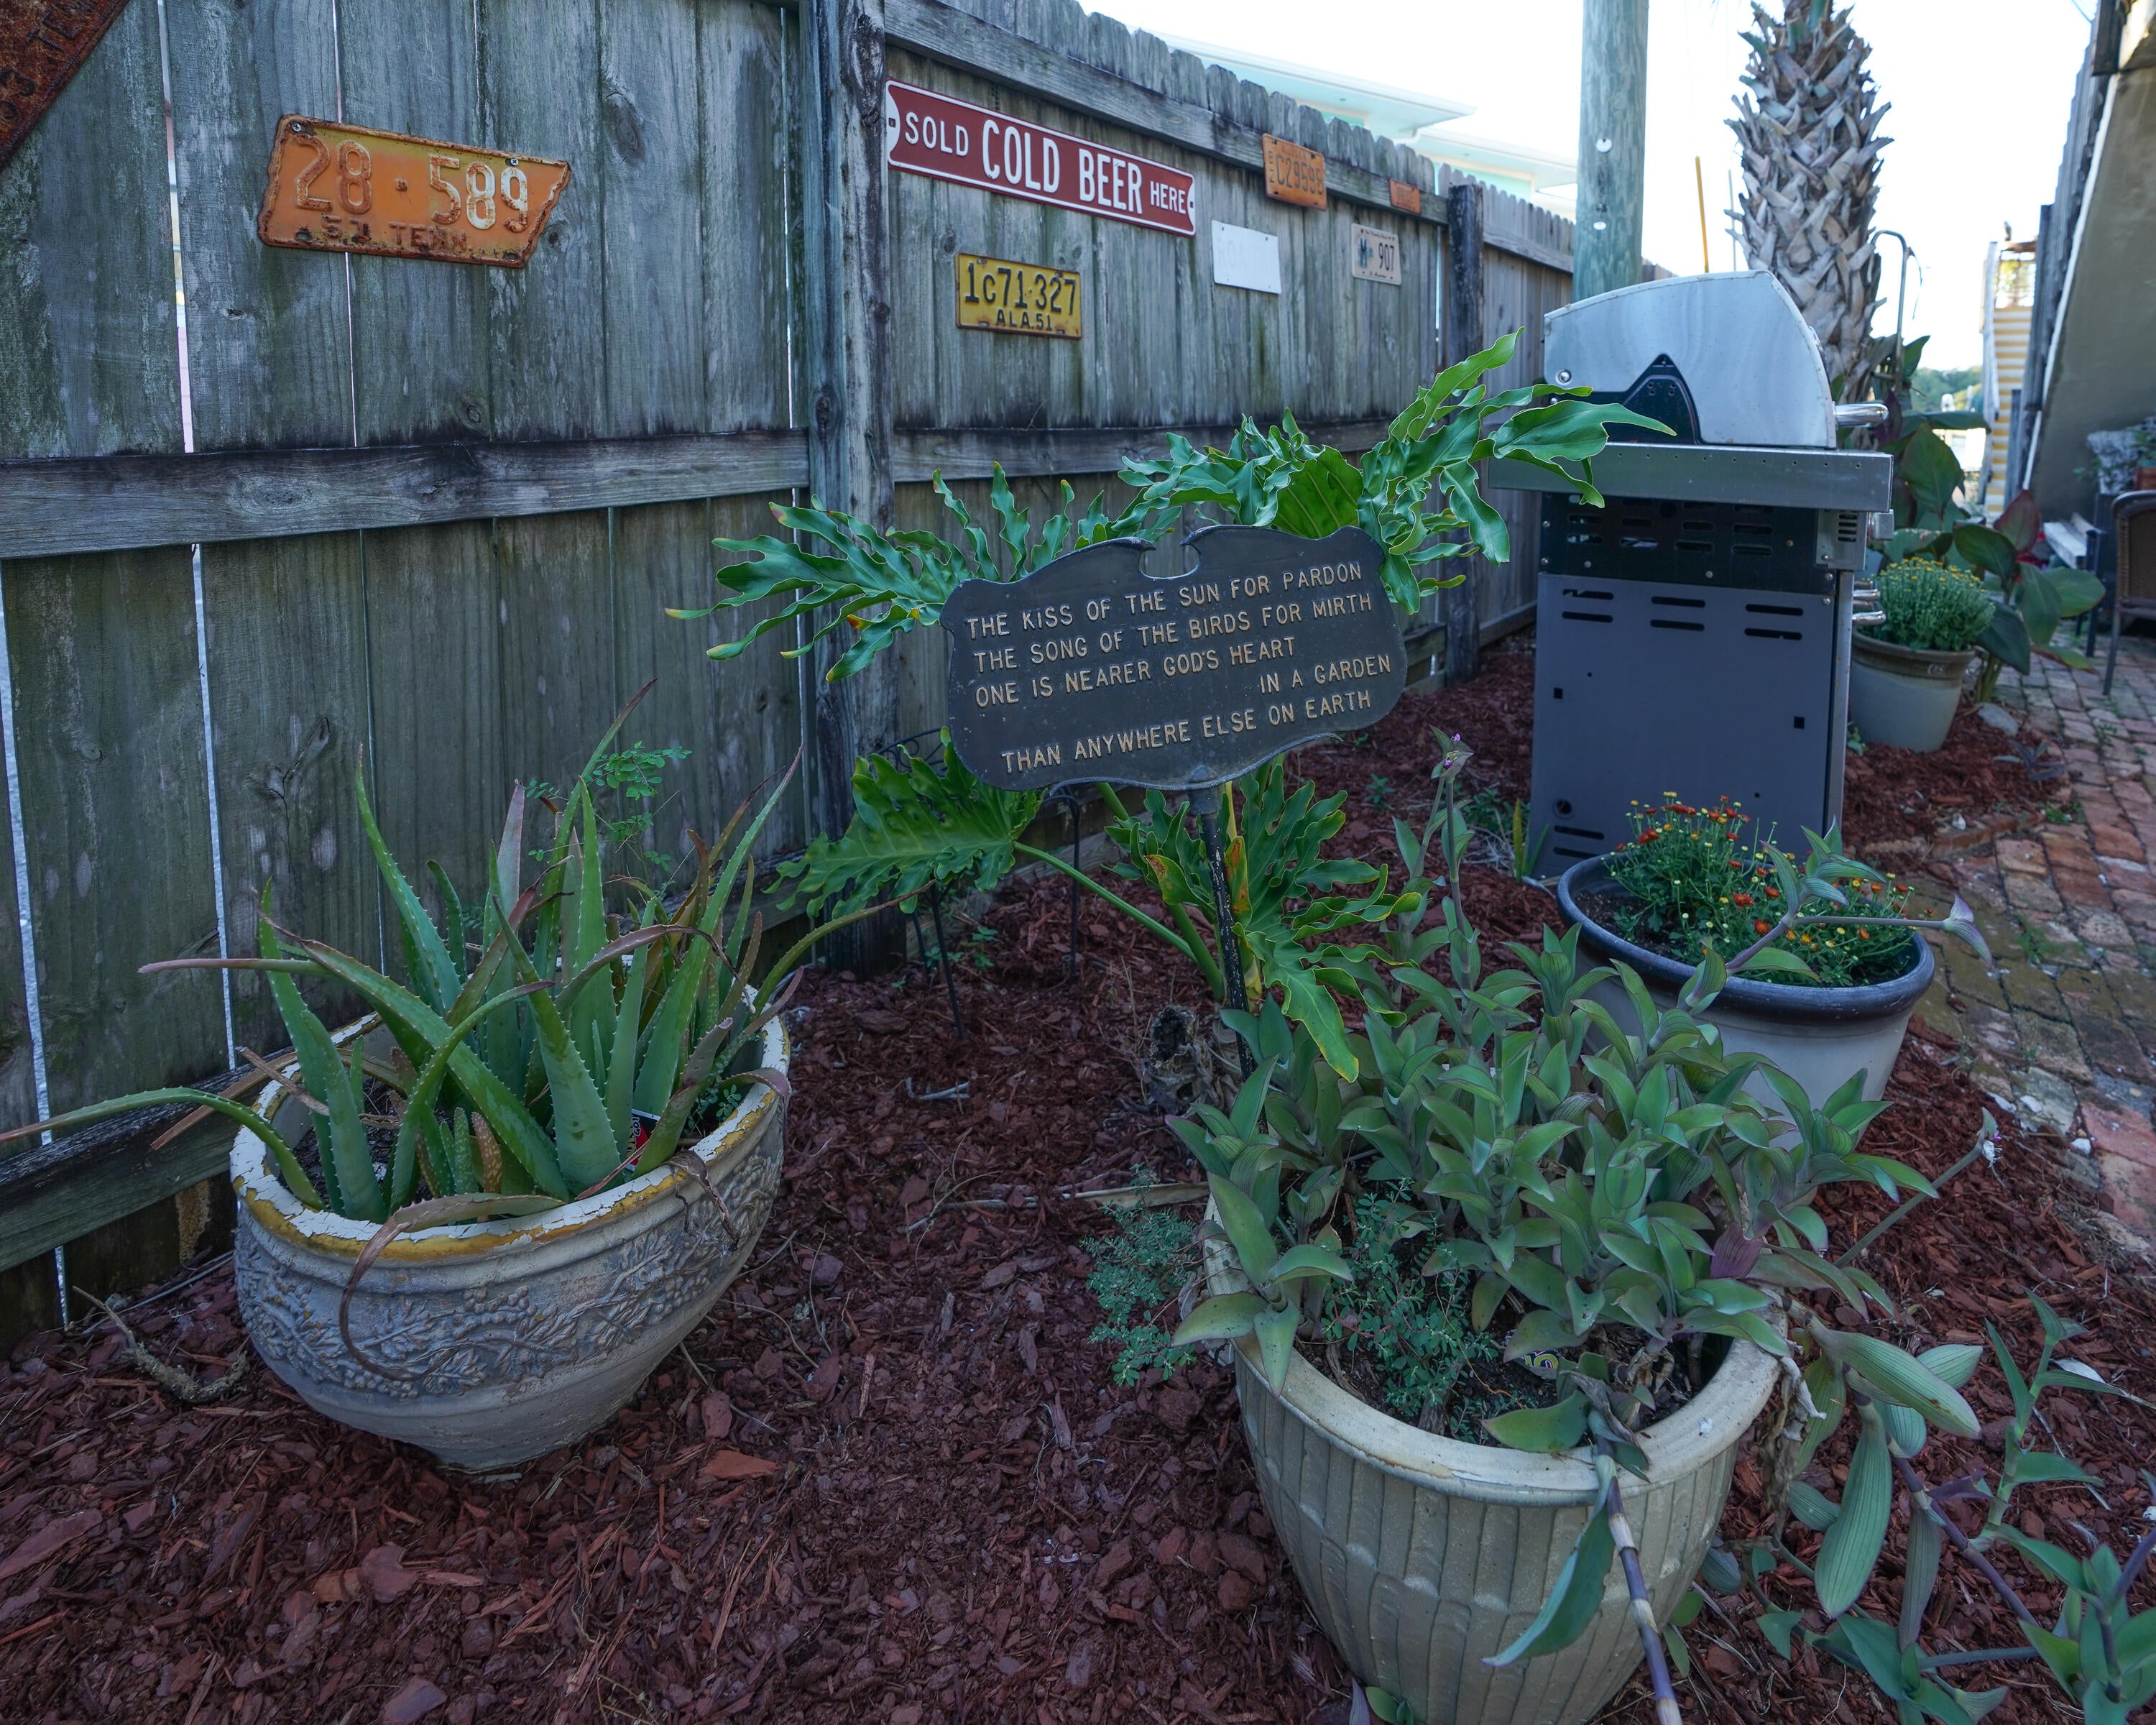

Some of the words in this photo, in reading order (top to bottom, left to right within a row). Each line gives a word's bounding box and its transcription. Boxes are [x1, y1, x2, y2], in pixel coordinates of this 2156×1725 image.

[292, 134, 373, 215] 28
[429, 155, 529, 233] 589
[904, 111, 969, 157] SOLD
[982, 119, 1060, 193] COLD
[1079, 148, 1143, 214] BEER
[1150, 180, 1187, 215] HERE
[389, 221, 473, 252] TENN.
[1378, 242, 1394, 272] 907
[967, 614, 1010, 640] THE
[1022, 605, 1074, 630] KISS
[1087, 598, 1111, 621] OF
[1125, 591, 1166, 615] THE
[1179, 584, 1220, 607] SUN
[1231, 576, 1270, 599] FOR
[1283, 563, 1362, 591] PARDON
[974, 648, 1018, 673] THE
[1031, 637, 1087, 664] SONG
[1100, 631, 1123, 653] OF
[1138, 622, 1179, 646] THE
[1189, 611, 1250, 640] BIRDS
[1262, 604, 1302, 627] FOR
[1313, 593, 1372, 619] MIRTH
[975, 682, 1019, 707] ONE
[1032, 676, 1053, 697] IS
[1065, 661, 1151, 694] NEARER
[1230, 637, 1294, 666] HEART
[1260, 672, 1279, 694] IN
[1292, 669, 1304, 688] A
[1314, 655, 1391, 684] GARDEN
[1001, 745, 1061, 773] THAN
[1074, 721, 1191, 760] ANYWHERE
[1202, 709, 1257, 738] ELSE
[1268, 704, 1294, 725] ON
[1306, 690, 1371, 719] EARTH
